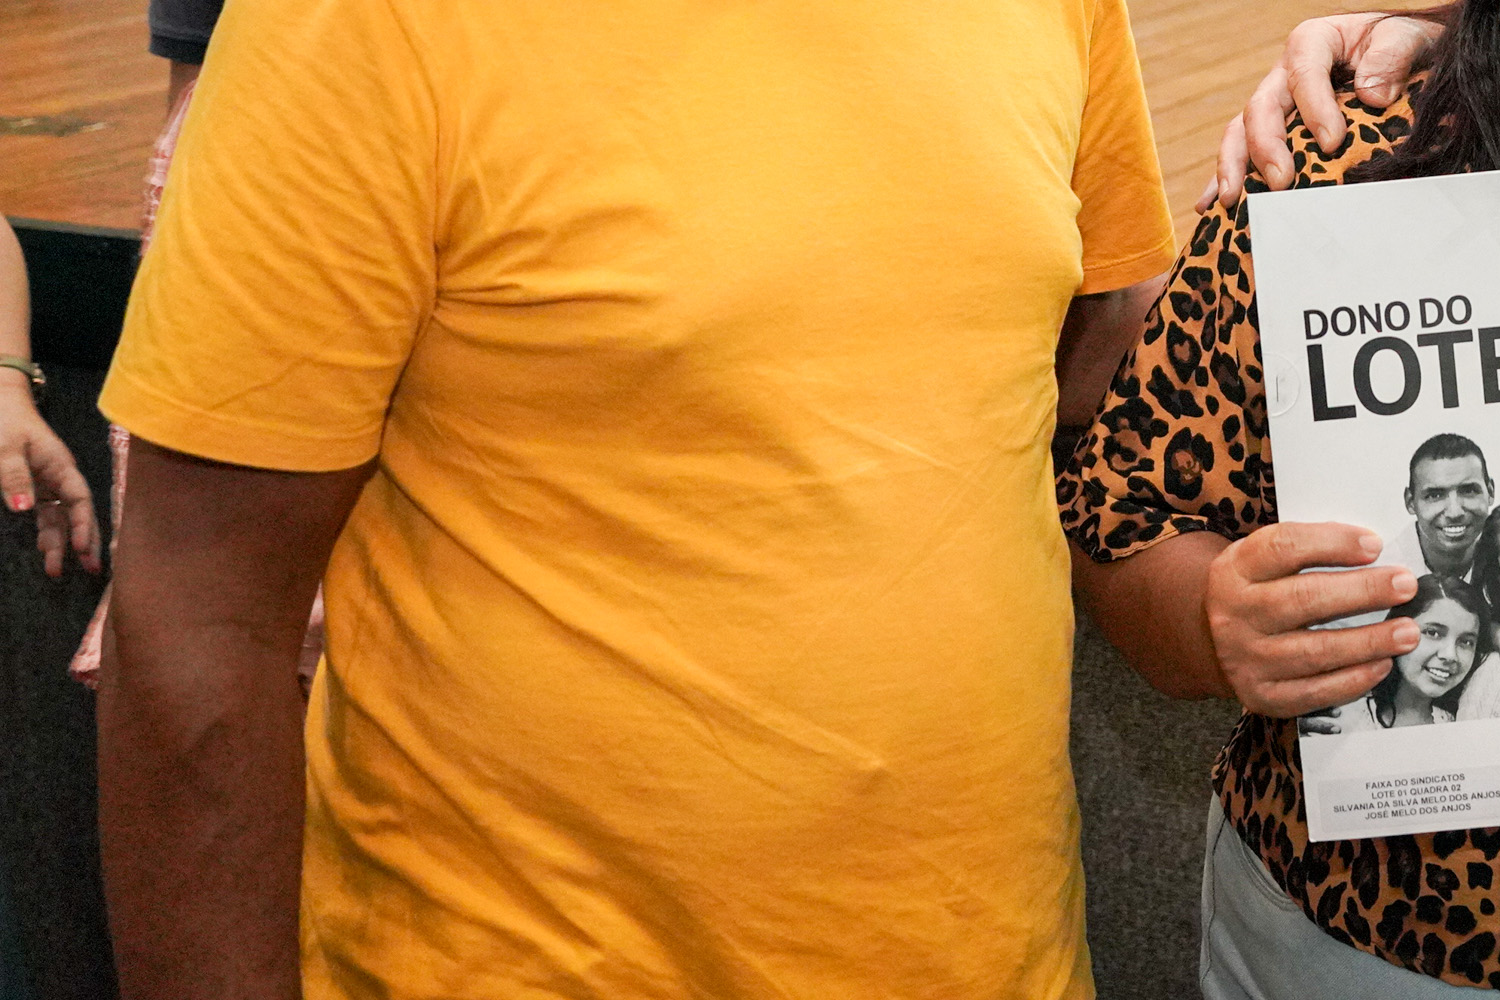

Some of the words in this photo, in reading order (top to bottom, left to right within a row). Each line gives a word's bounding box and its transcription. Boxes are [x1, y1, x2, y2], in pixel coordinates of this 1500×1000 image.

[1303, 301, 1411, 340] DONO
[1419, 295, 1472, 329] DO
[1365, 780, 1393, 790] FAIXA
[1394, 778, 1408, 787] DO
[1410, 773, 1465, 786] SINDICATOS
[1371, 790, 1395, 799] LOTE
[1397, 788, 1408, 797] 01
[1409, 786, 1449, 796] QUADRA
[1451, 784, 1462, 792] 02
[1333, 802, 1375, 813] SILVANIA
[1377, 800, 1390, 809] DA
[1393, 798, 1419, 807] SILVA
[1421, 795, 1447, 804] MELO
[1449, 793, 1468, 801] DOS
[1365, 808, 1389, 820] JOSÉ
[1391, 808, 1417, 817] MELO
[1419, 806, 1438, 815] DOS
[1441, 803, 1472, 812] ANJOS
